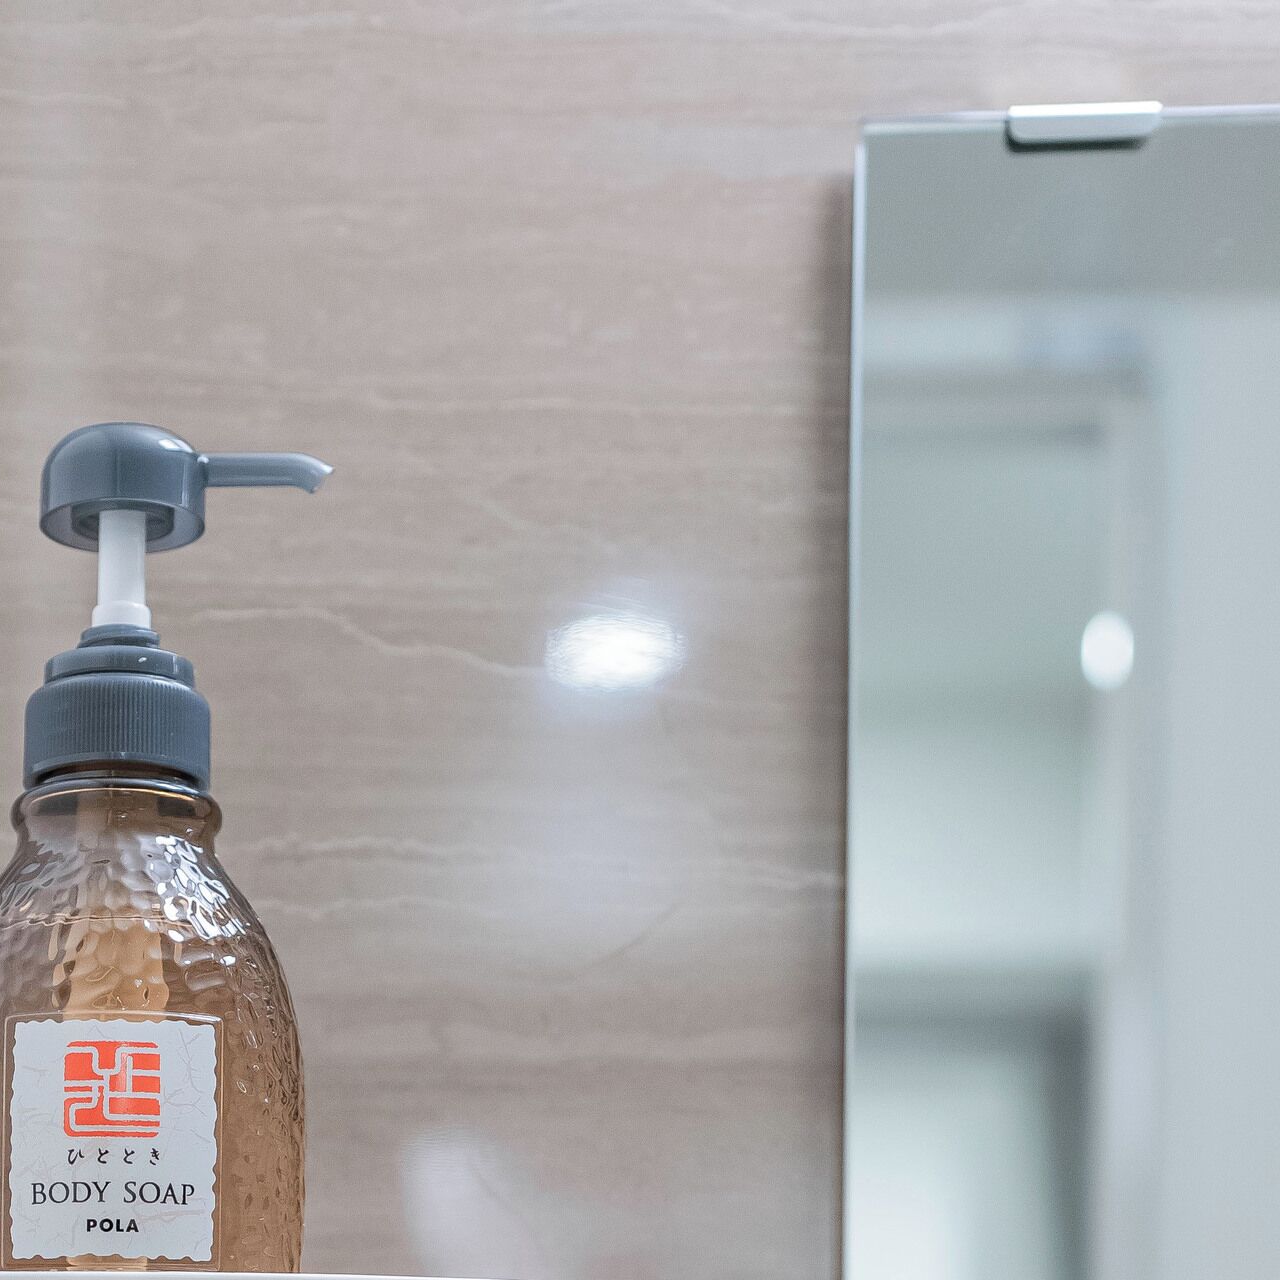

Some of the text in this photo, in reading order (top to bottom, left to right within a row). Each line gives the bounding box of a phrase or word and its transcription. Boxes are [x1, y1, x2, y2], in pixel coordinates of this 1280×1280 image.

[67, 1147, 160, 1166] ひととき
[31, 1181, 195, 1206] BODY SOAP
[86, 1218, 140, 1233] POLA
